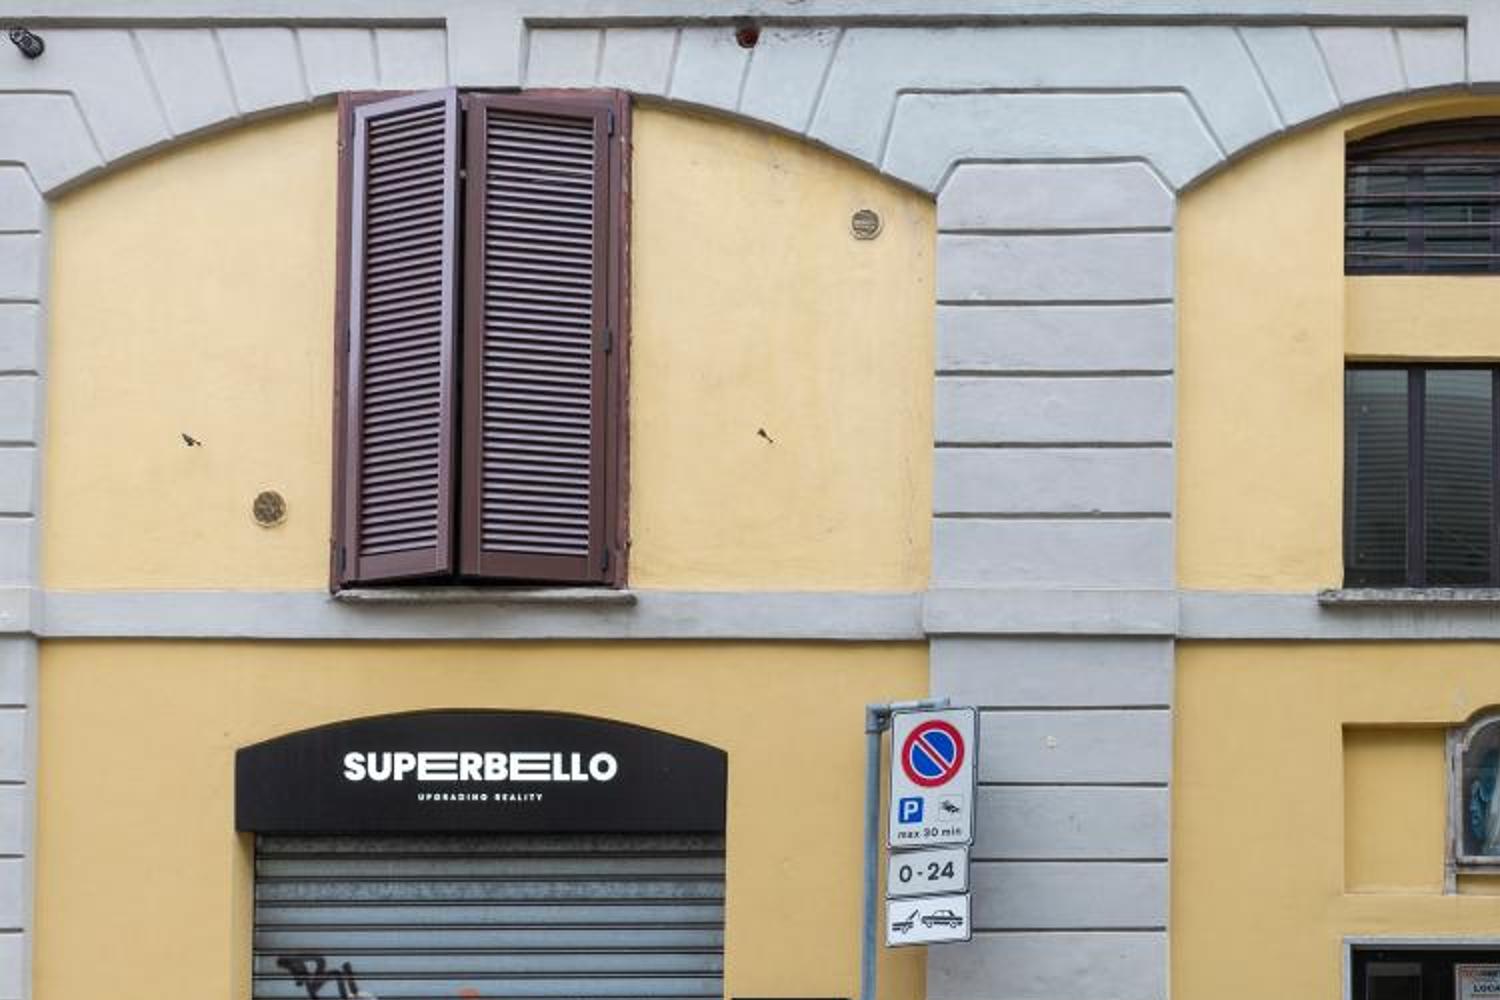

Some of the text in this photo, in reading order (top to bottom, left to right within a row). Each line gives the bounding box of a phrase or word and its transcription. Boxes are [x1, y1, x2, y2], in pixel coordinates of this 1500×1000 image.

[343, 751, 618, 781] SUPERBELLO
[494, 793, 543, 801] REALITY
[902, 800, 919, 821] P
[897, 826, 962, 839] max 30 min
